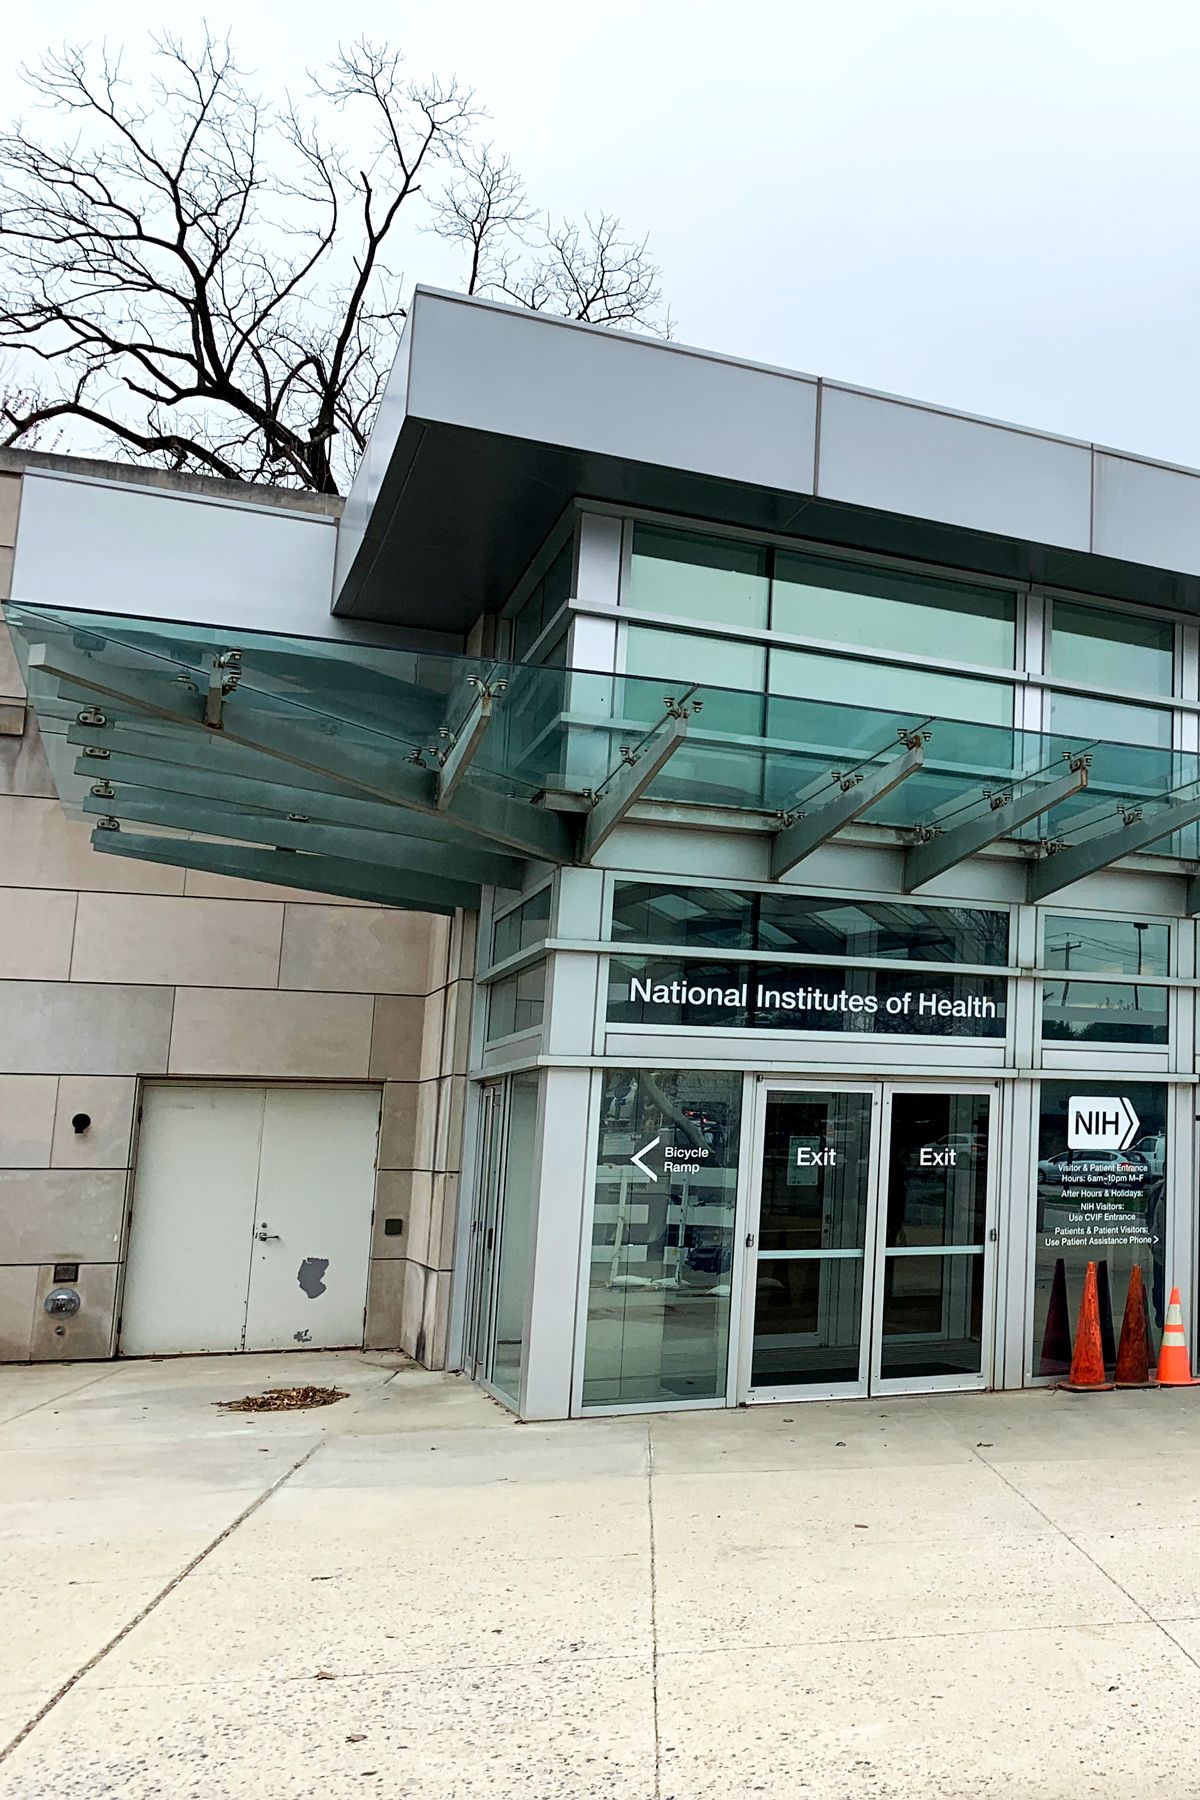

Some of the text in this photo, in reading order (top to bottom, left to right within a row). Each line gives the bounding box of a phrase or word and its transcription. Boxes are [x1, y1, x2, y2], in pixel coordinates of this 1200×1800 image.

[630, 977, 997, 1019] National Institutes of Health
[1075, 1110, 1120, 1135] NIH
[664, 1146, 709, 1160] Bicycle
[796, 1146, 837, 1167] Exit
[919, 1147, 957, 1167] Exit
[664, 1161, 700, 1175] Ramp
[1058, 1163, 1148, 1172] Visitor & Patient Entrance
[1061, 1174, 1086, 1182] Hours:
[1061, 1189, 1144, 1199] After Hours & Holidays:
[1080, 1202, 1125, 1211] NIH Visitors:
[1068, 1212, 1136, 1222] Use CVIF Entrance
[1054, 1225, 1149, 1235] Patients & Patient Visitors:
[1045, 1235, 1152, 1247] Use Patient Assistance Phone
